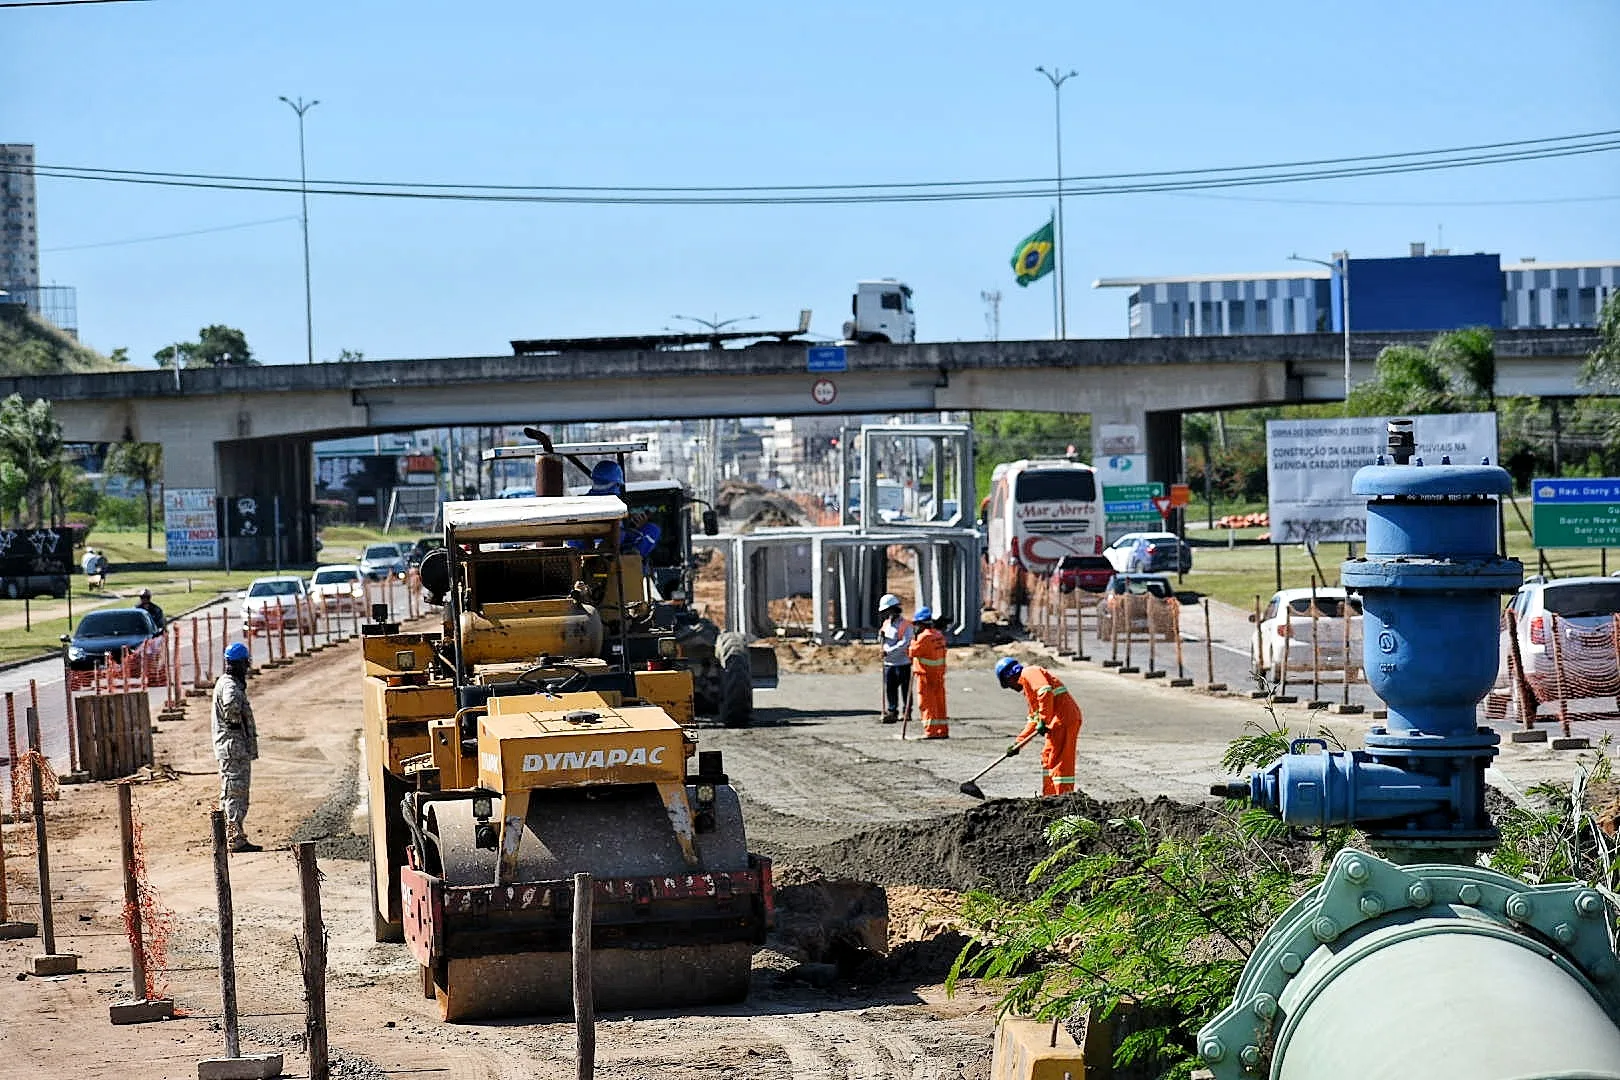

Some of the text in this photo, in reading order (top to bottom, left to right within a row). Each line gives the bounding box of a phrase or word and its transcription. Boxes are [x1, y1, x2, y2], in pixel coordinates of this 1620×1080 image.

[1272, 446, 1327, 458] CONSTRUÇÃO
[1340, 444, 1374, 456] GALERIA
[1016, 502, 1050, 519] Mar
[1051, 501, 1096, 518] Aberto
[522, 745, 667, 773] DYNAPAC
